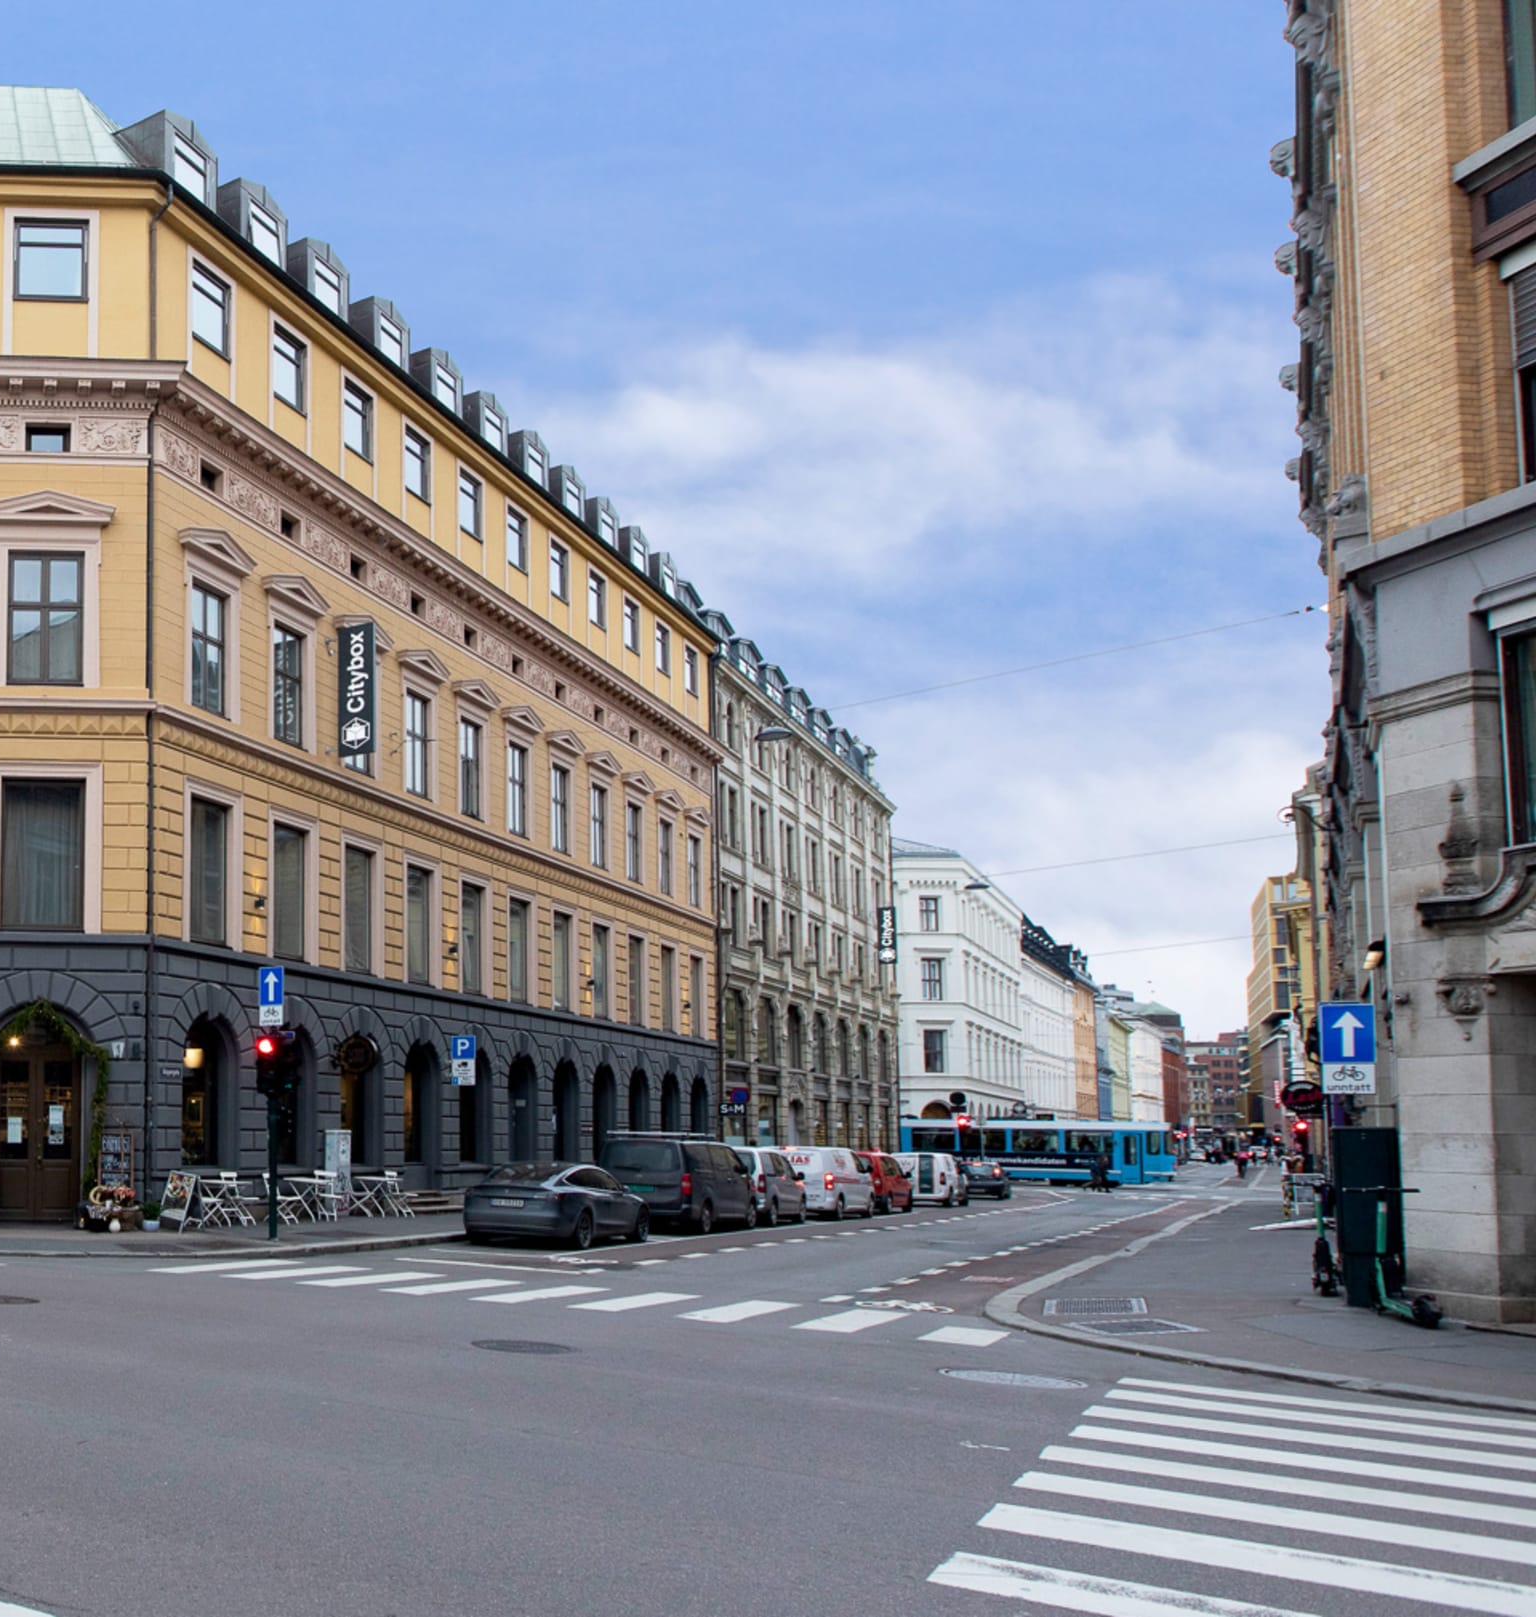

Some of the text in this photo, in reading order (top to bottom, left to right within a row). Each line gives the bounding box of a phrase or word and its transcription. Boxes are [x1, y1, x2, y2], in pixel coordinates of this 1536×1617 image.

[346, 631, 369, 713] Citybox
[881, 910, 895, 946] Citybox
[457, 1039, 470, 1056] P
[1327, 1083, 1372, 1092] unntatt
[720, 1103, 745, 1114] S&M
